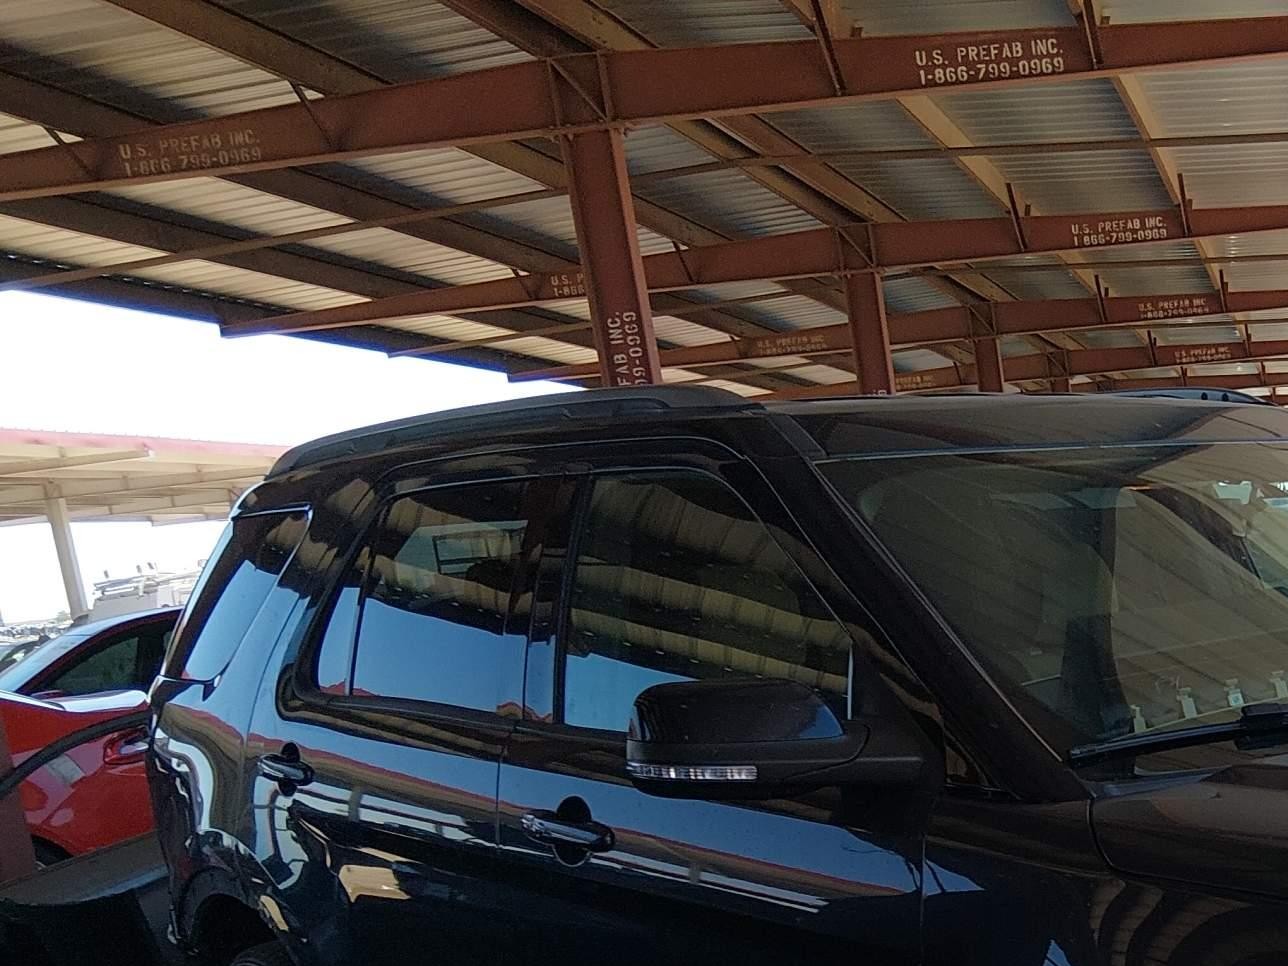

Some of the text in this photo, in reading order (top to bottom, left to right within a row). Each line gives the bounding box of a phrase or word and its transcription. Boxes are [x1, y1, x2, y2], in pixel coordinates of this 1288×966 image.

[915, 38, 1064, 66] U.S. PREFAB INC.
[919, 57, 1065, 86] 1-866-799-0969
[159, 134, 221, 154] PREFAB
[229, 129, 260, 145] INC.
[1071, 216, 1167, 235] U.S. PREFAB INC.
[607, 311, 625, 345] INC.
